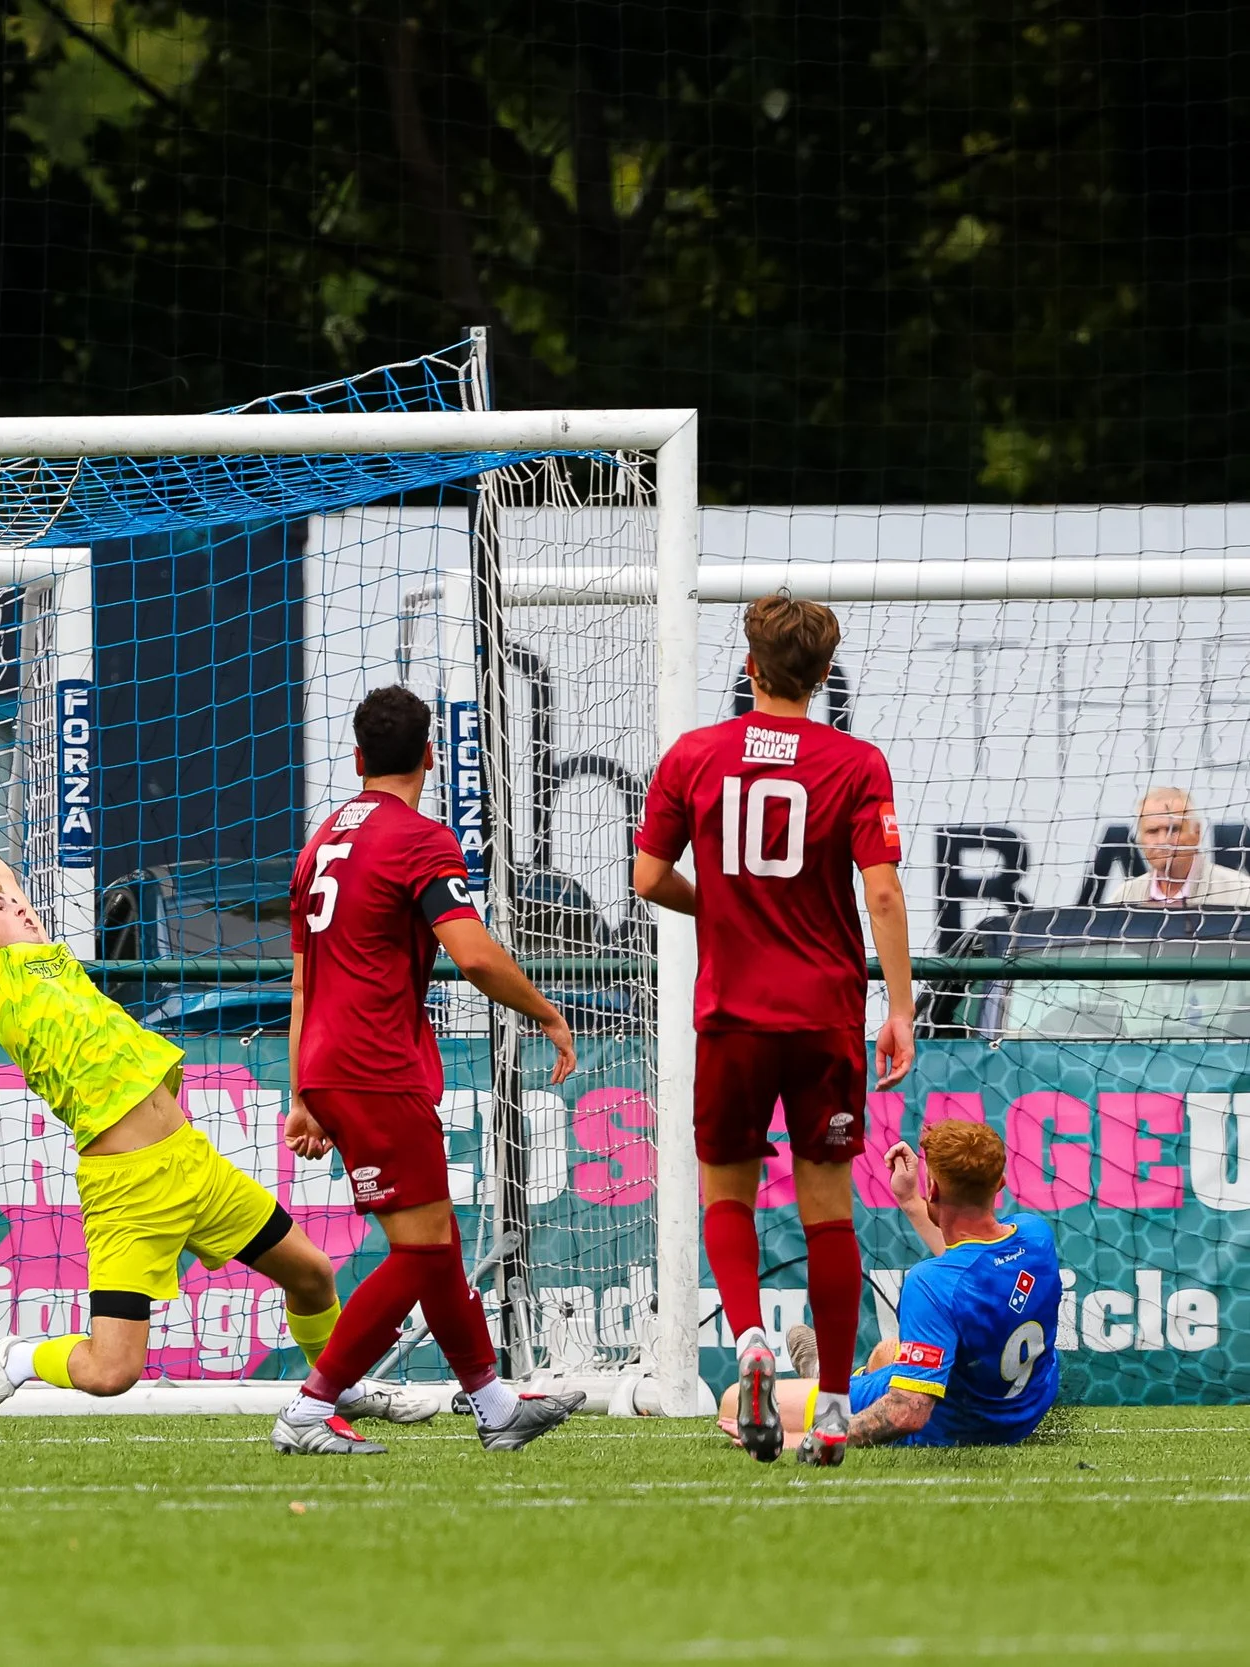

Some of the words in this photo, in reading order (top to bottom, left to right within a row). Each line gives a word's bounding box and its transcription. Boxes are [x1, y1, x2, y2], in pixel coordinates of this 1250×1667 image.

[63, 689, 92, 833] FORZA
[458, 711, 483, 857] FORZA
[744, 738, 798, 759] TOUCH
[723, 776, 807, 878] 10
[306, 842, 353, 933] 5
[447, 877, 471, 903] C
[357, 1180, 377, 1190] PRO
[1001, 1320, 1046, 1399] 9
